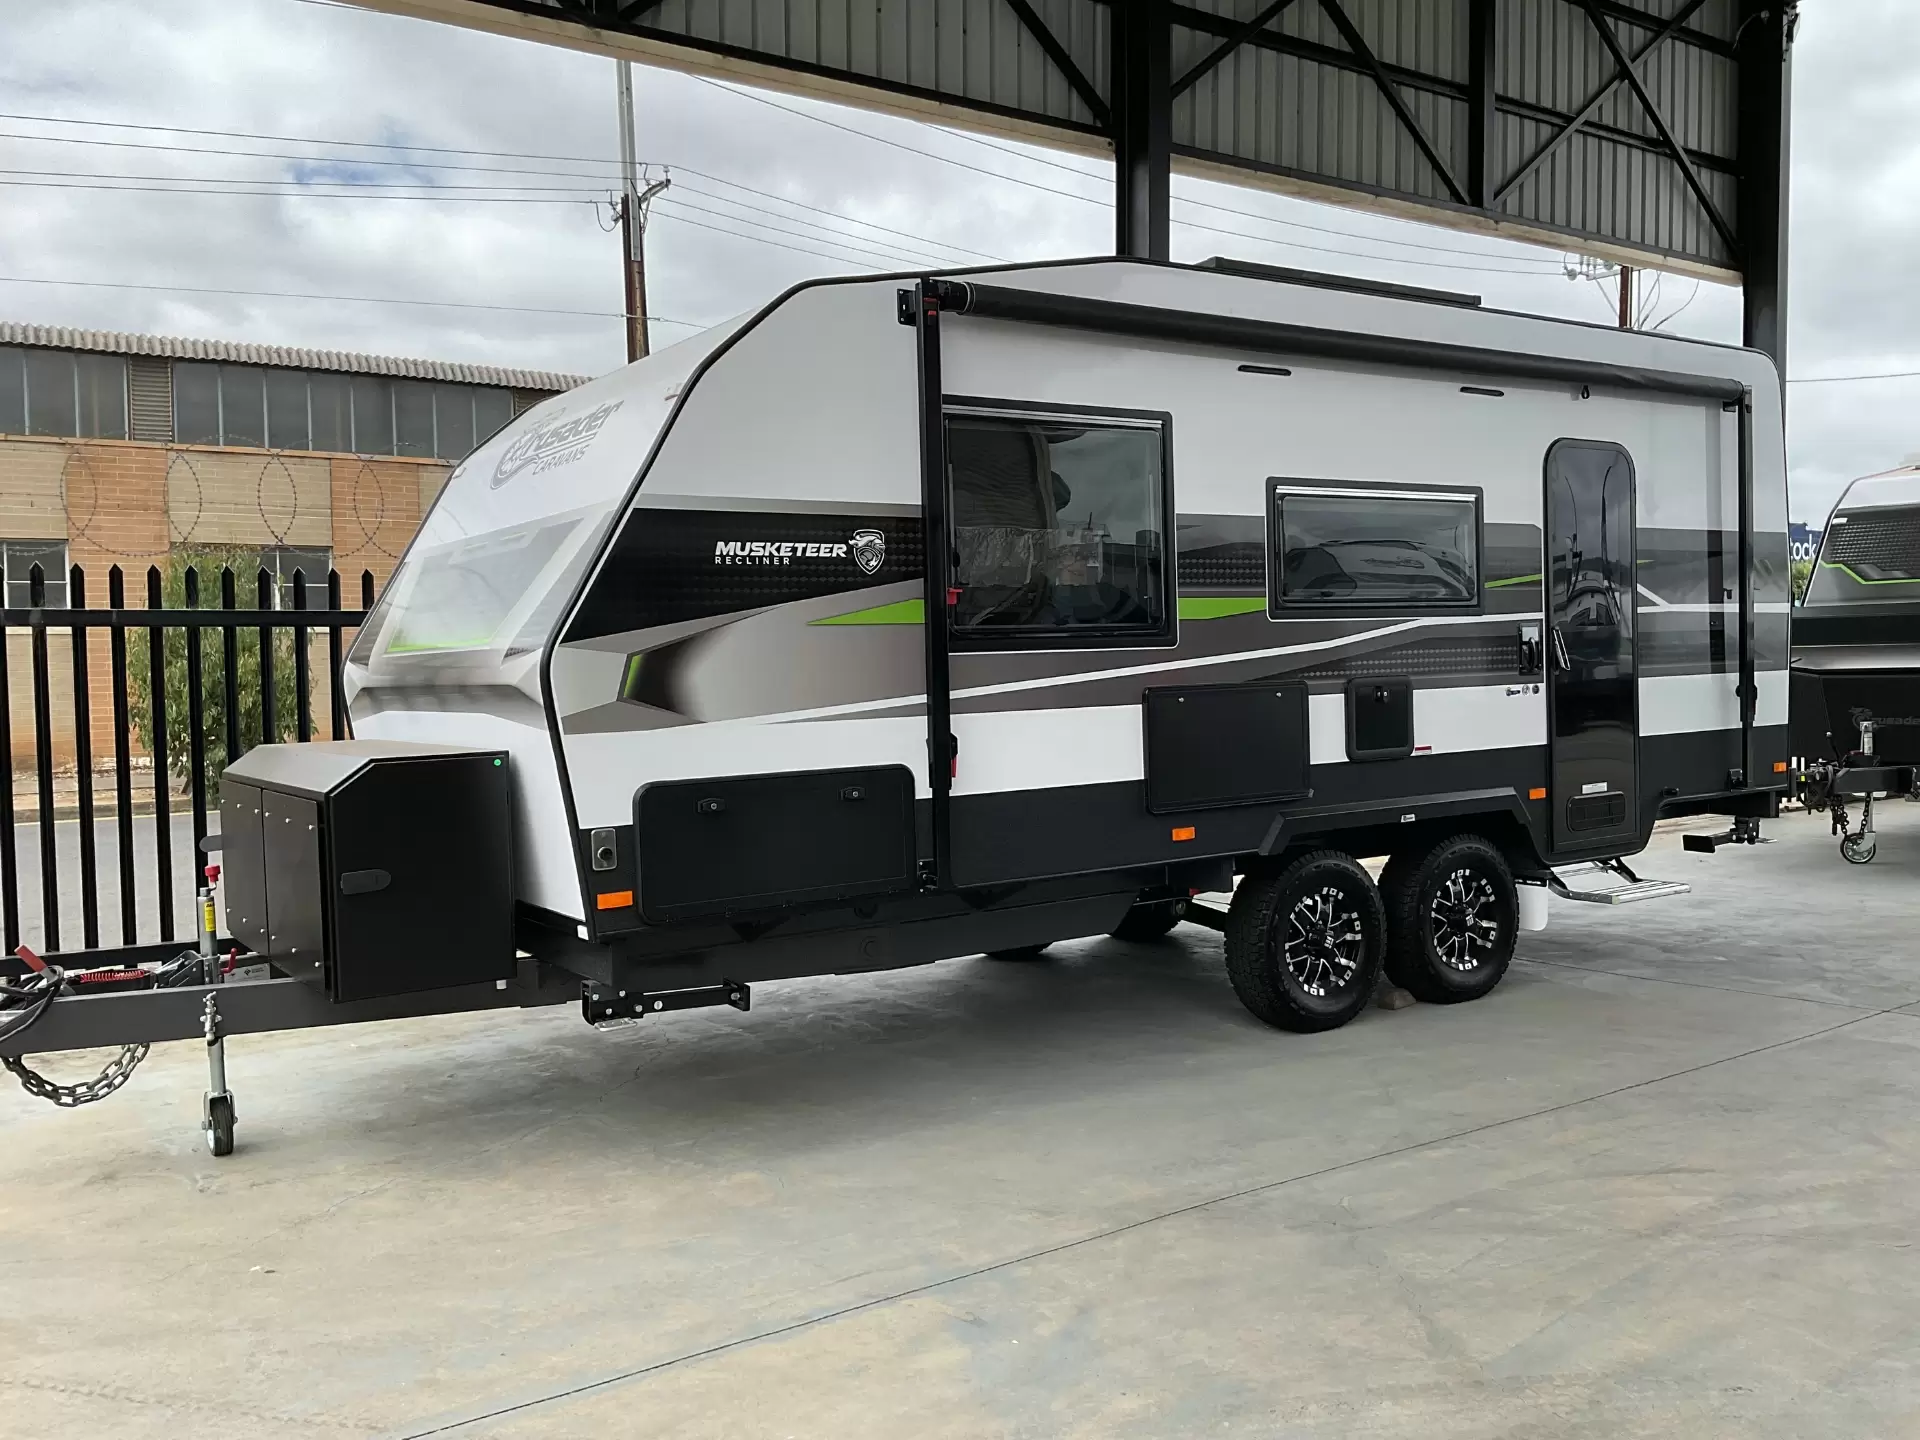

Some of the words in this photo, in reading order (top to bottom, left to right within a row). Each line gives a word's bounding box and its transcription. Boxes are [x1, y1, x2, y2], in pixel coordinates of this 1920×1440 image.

[532, 444, 592, 476] CARAVANS
[715, 541, 847, 558] MUSKETEER
[715, 556, 790, 565] RECLINER
